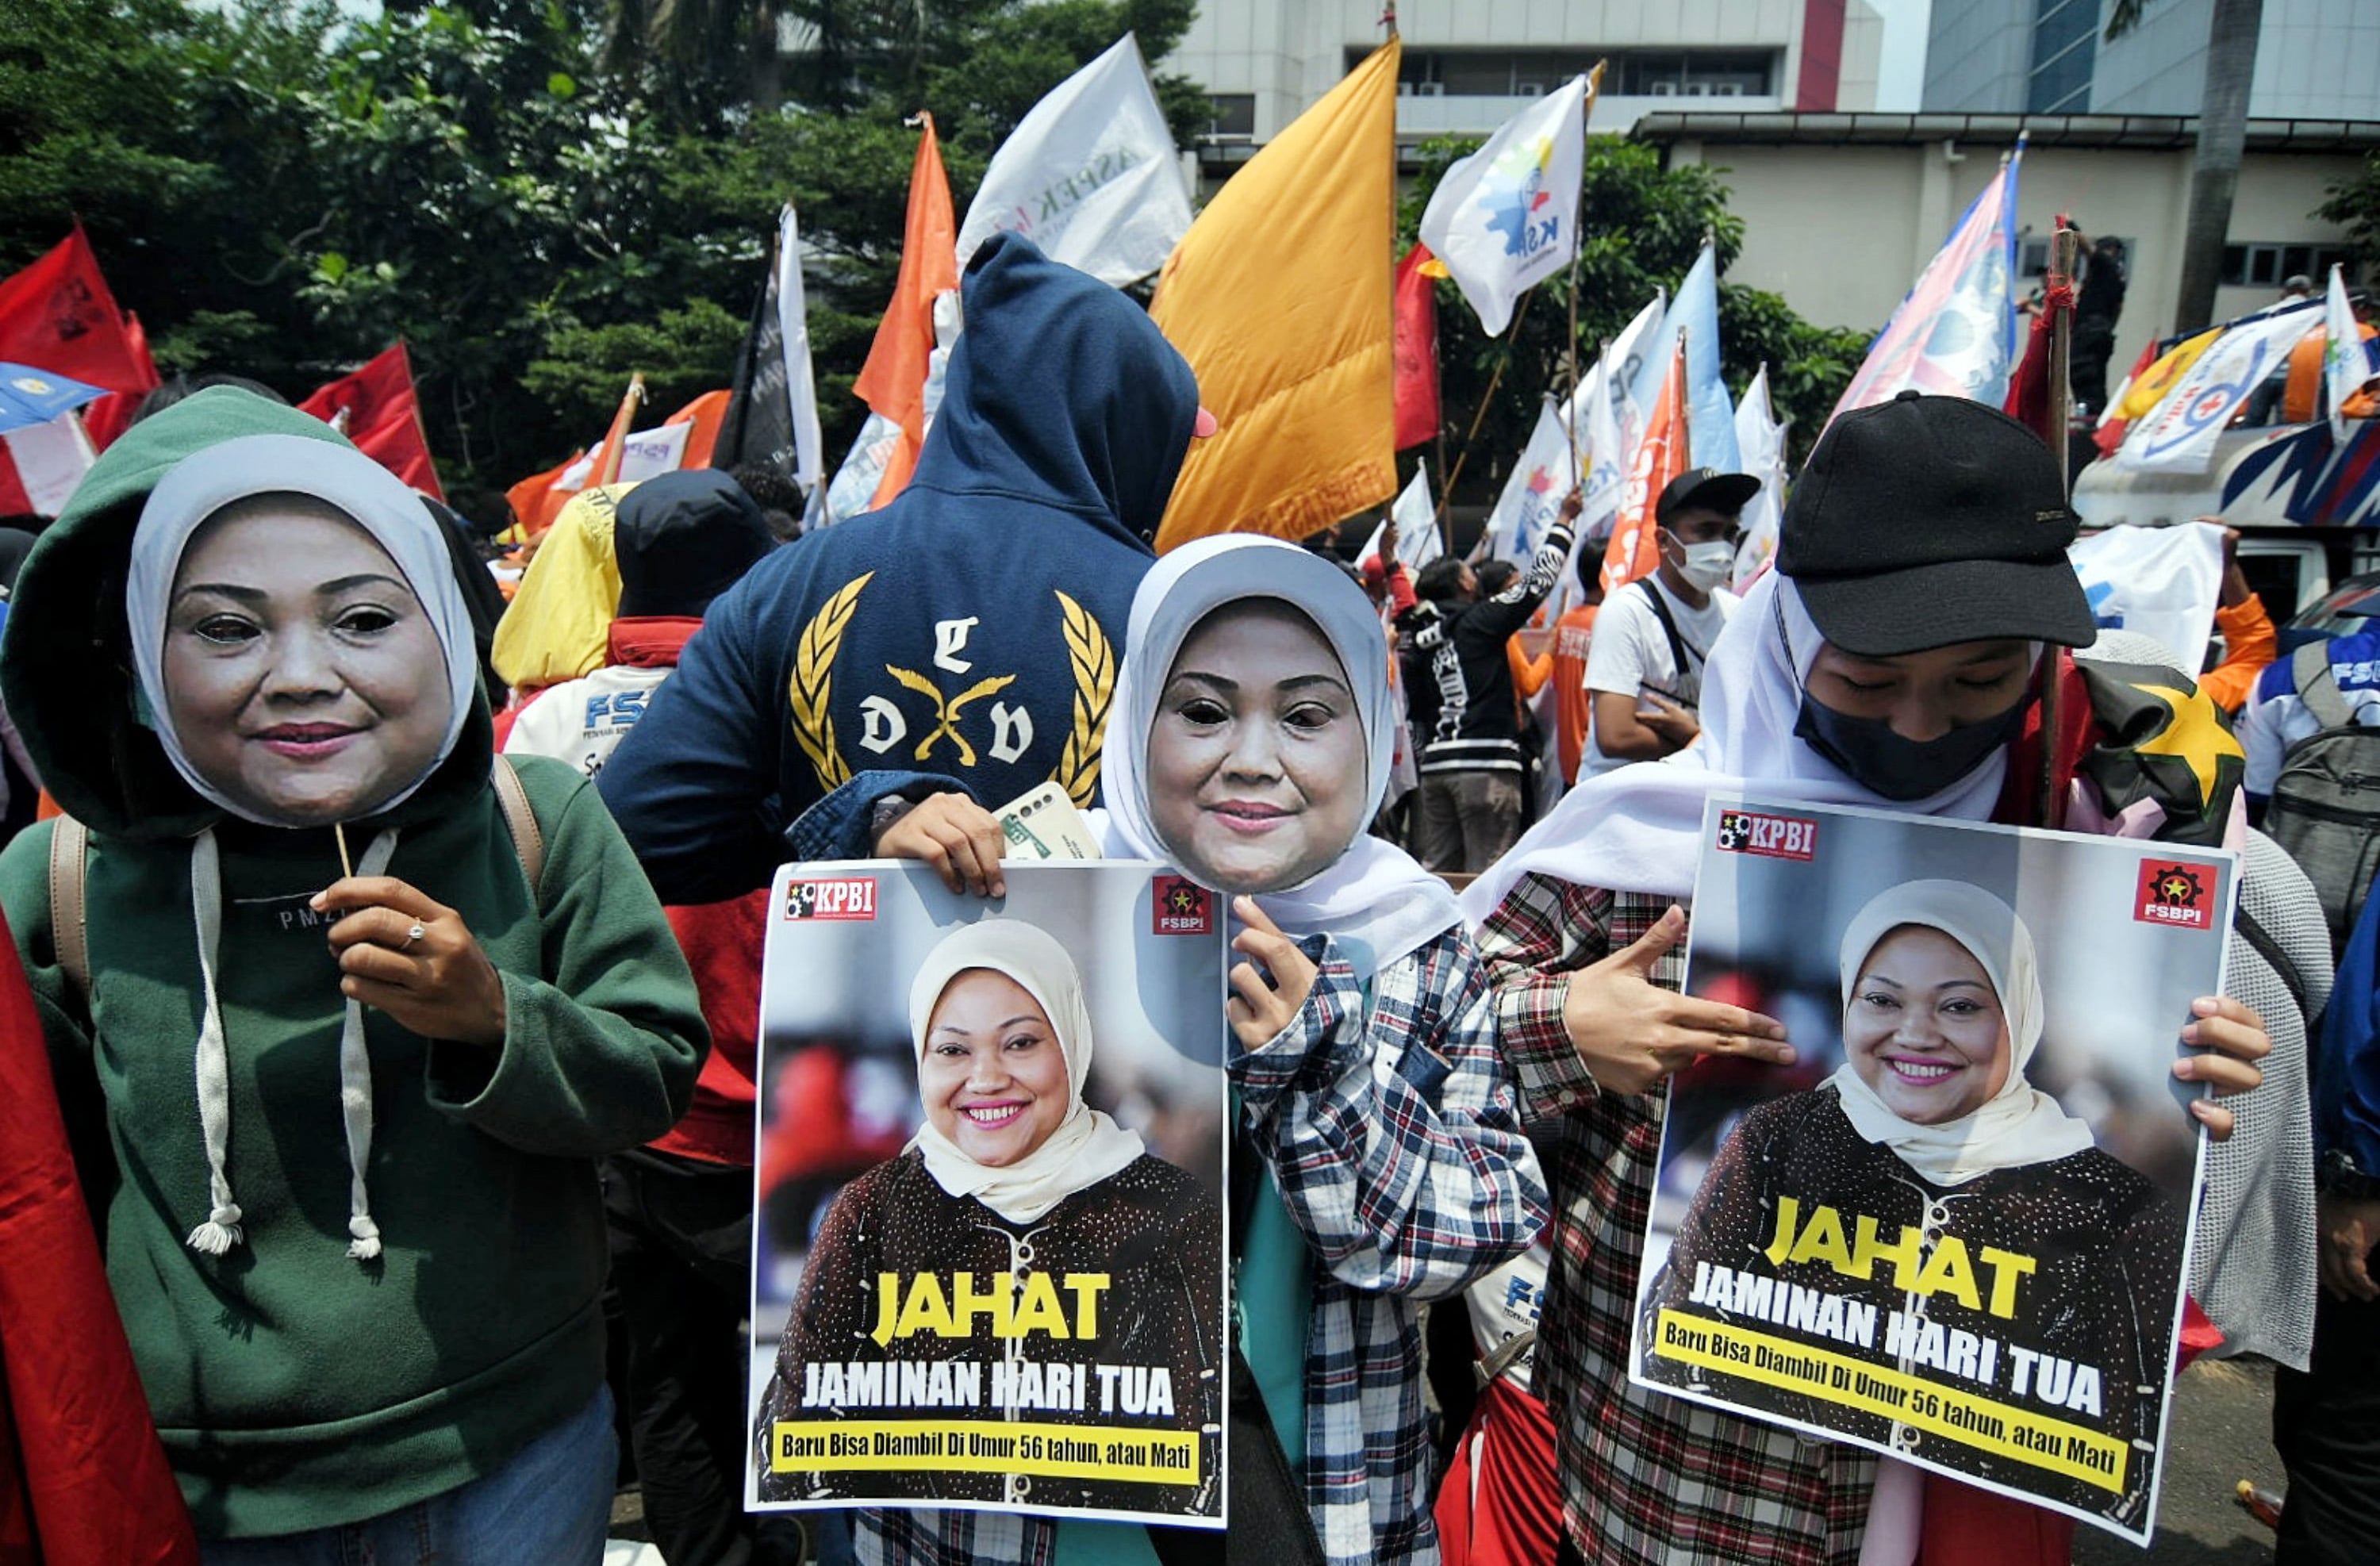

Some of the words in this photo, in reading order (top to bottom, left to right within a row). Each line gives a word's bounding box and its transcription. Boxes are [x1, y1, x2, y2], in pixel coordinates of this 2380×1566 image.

[1749, 817, 1814, 853] KPBI
[816, 881, 873, 912] KPBI
[2144, 904, 2202, 923] FSBPI
[1161, 917, 1204, 929] FSBPI
[1764, 1196, 2036, 1320] JAHAT
[871, 1271, 1111, 1348] JAHAT
[1688, 1261, 1877, 1349] JAMINAN
[1885, 1310, 1998, 1385] HARI
[2009, 1342, 2101, 1417] TUA
[802, 1361, 981, 1408] JAMINAN
[991, 1363, 1084, 1413] HARI
[1096, 1364, 1175, 1416] TUA
[1665, 1321, 1706, 1353] Baru
[1711, 1334, 1750, 1364] Bisa
[1755, 1344, 1828, 1385] Diambil
[1831, 1364, 1851, 1391] Di
[1856, 1372, 1908, 1408] Umur
[1912, 1390, 1938, 1418] 56
[1944, 1401, 2007, 1444] tahun,
[2013, 1425, 2062, 1457] atau
[2067, 1437, 2116, 1475] Mati
[782, 1434, 824, 1457] Baru
[830, 1433, 868, 1457] Bisa
[874, 1432, 942, 1457] Diambil
[948, 1432, 964, 1457] Di
[969, 1433, 1016, 1458] Umur
[1020, 1434, 1042, 1460] 56
[1047, 1437, 1102, 1466] tahun,
[1107, 1442, 1146, 1467] atau
[1150, 1442, 1190, 1469] Mati
